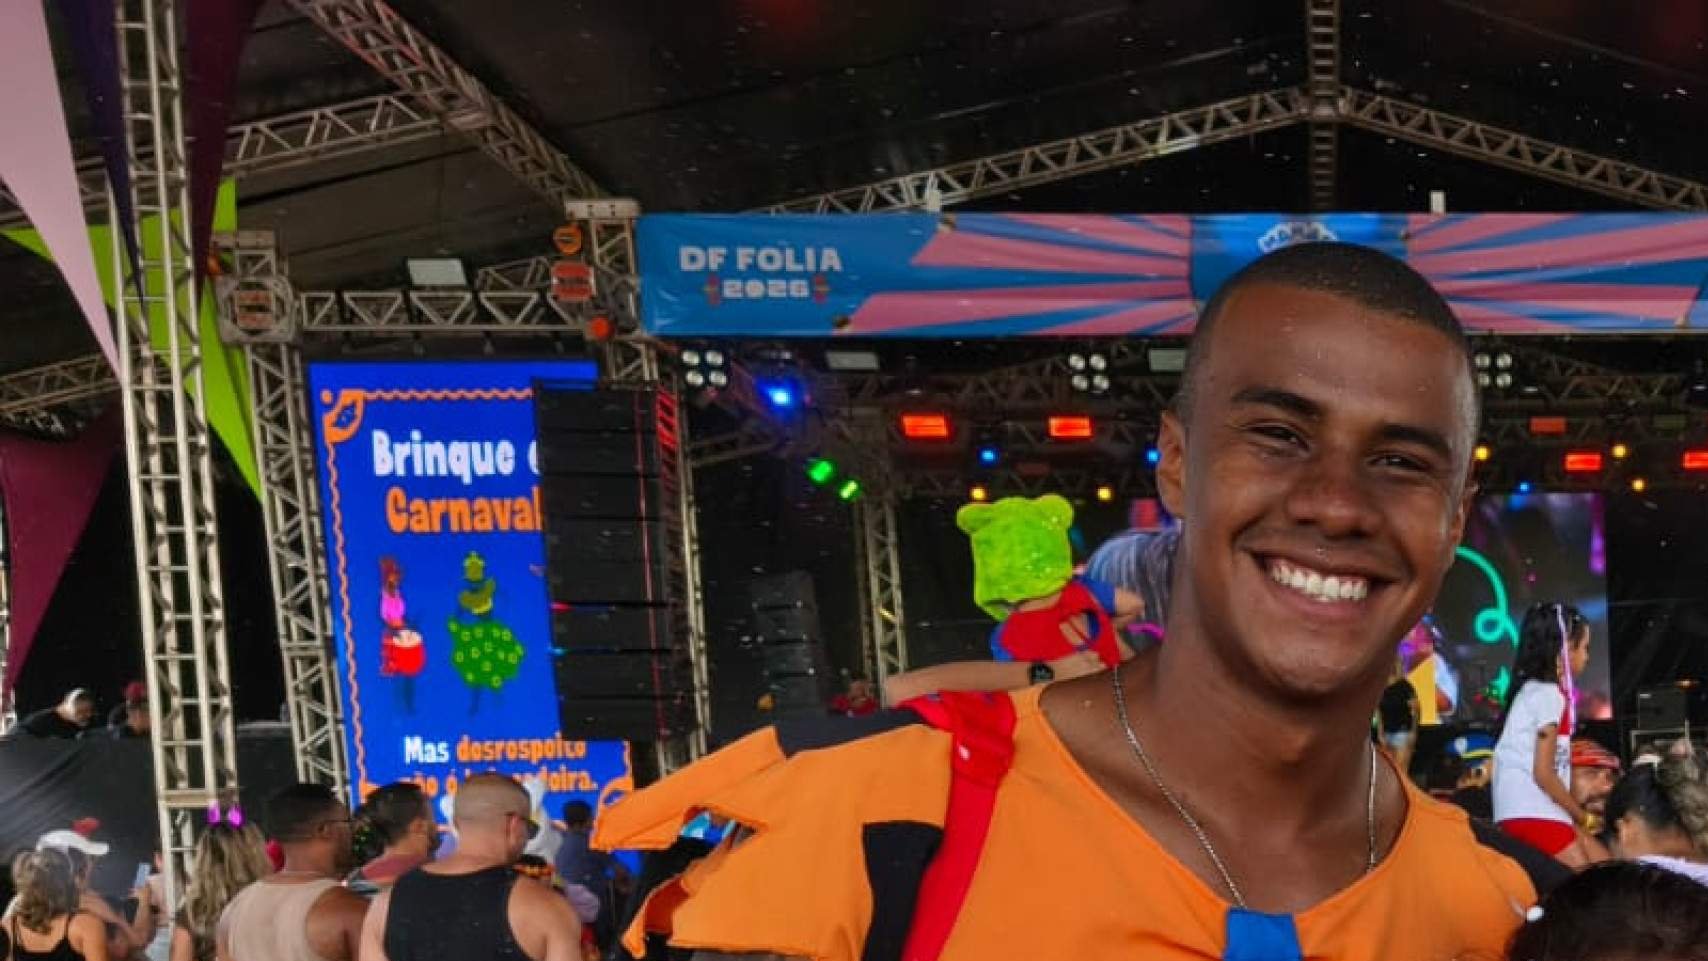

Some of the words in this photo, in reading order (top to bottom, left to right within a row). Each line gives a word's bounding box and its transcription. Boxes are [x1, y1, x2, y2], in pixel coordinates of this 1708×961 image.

[680, 246, 727, 272] DF
[736, 246, 843, 272] FOLIA
[722, 279, 811, 298] 2026
[372, 429, 516, 485] Brinque
[386, 486, 544, 533] Carnaval
[403, 735, 450, 764] Mas
